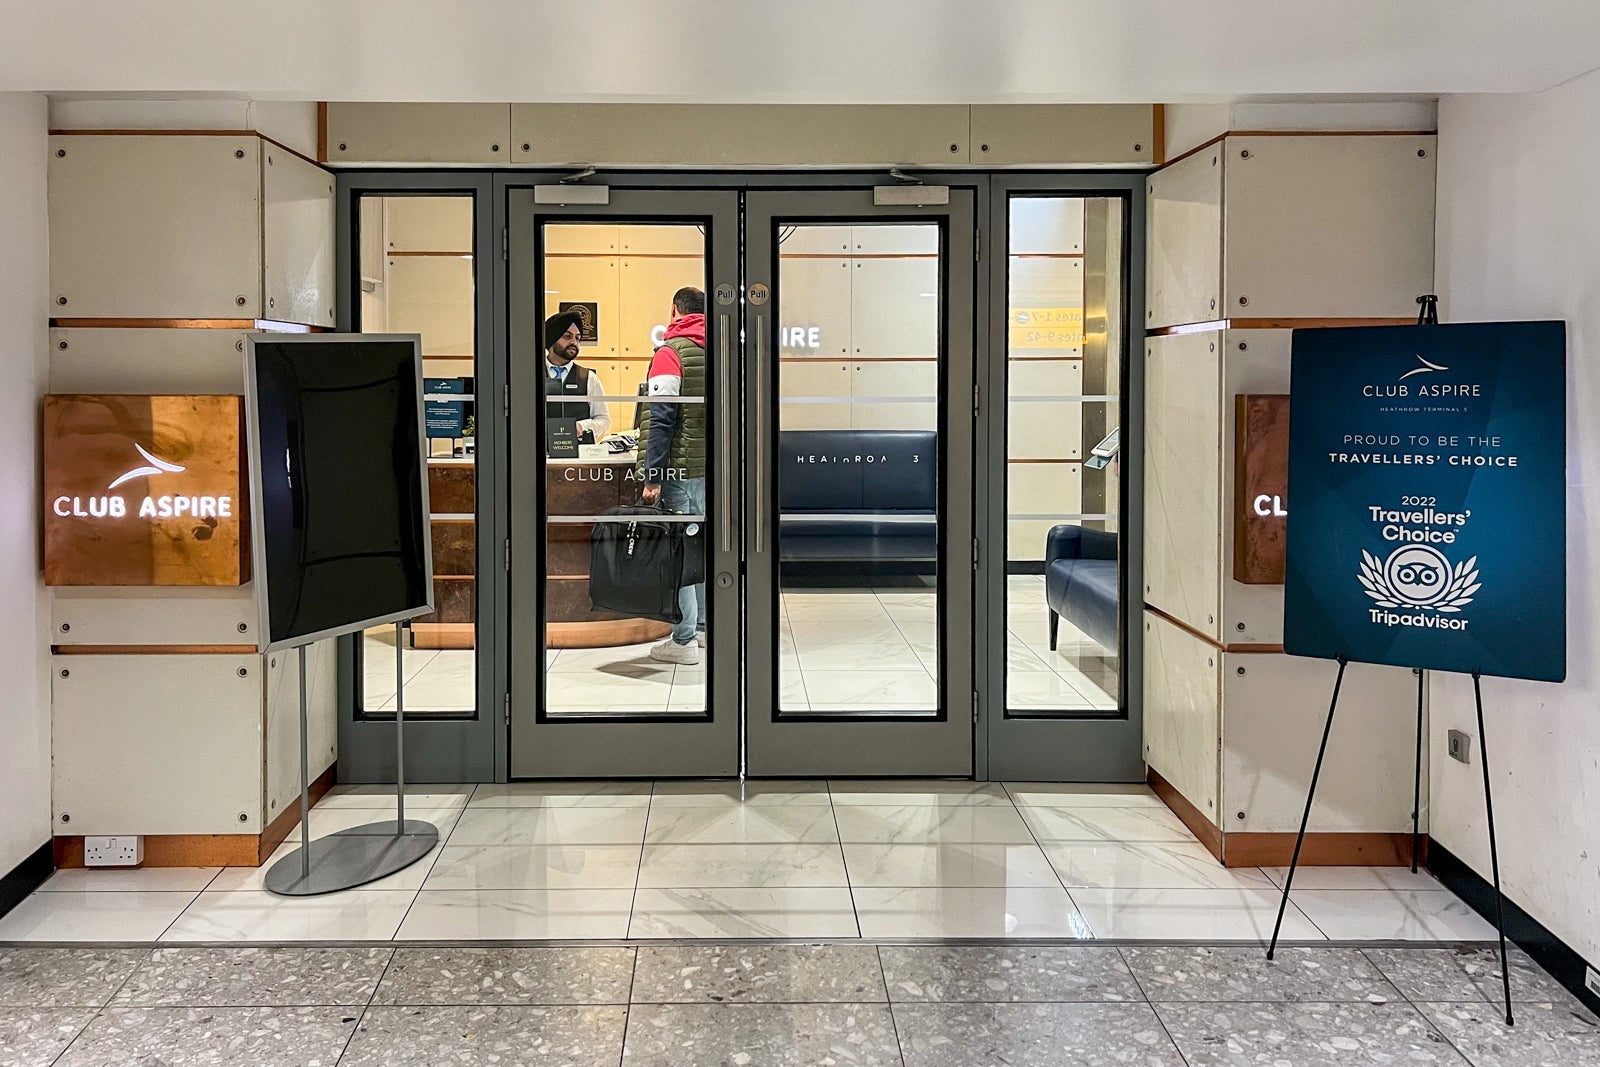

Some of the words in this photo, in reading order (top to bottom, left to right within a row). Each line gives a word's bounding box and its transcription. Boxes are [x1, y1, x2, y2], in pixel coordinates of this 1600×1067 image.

[717, 290, 733, 299] Pull
[750, 290, 766, 299] Pull
[1362, 385, 1409, 397] CLUB
[1418, 384, 1480, 397] ASPIRE
[1343, 434, 1400, 446] PROUD
[1408, 435, 1430, 446] TO
[1438, 436, 1459, 447] BE
[1467, 436, 1501, 447] THE
[1328, 453, 1441, 465] TRAVELLERS’
[1448, 455, 1518, 467] CHOICE
[564, 467, 614, 481] CLUB
[624, 467, 687, 481] ASPIRE
[53, 496, 126, 517] CLUB
[139, 496, 232, 517] ASPIRE
[1253, 494, 1288, 516] CL
[1401, 495, 1436, 506] 2022
[1368, 506, 1471, 526] Travellers’
[1368, 608, 1469, 631] Tripadvisor
